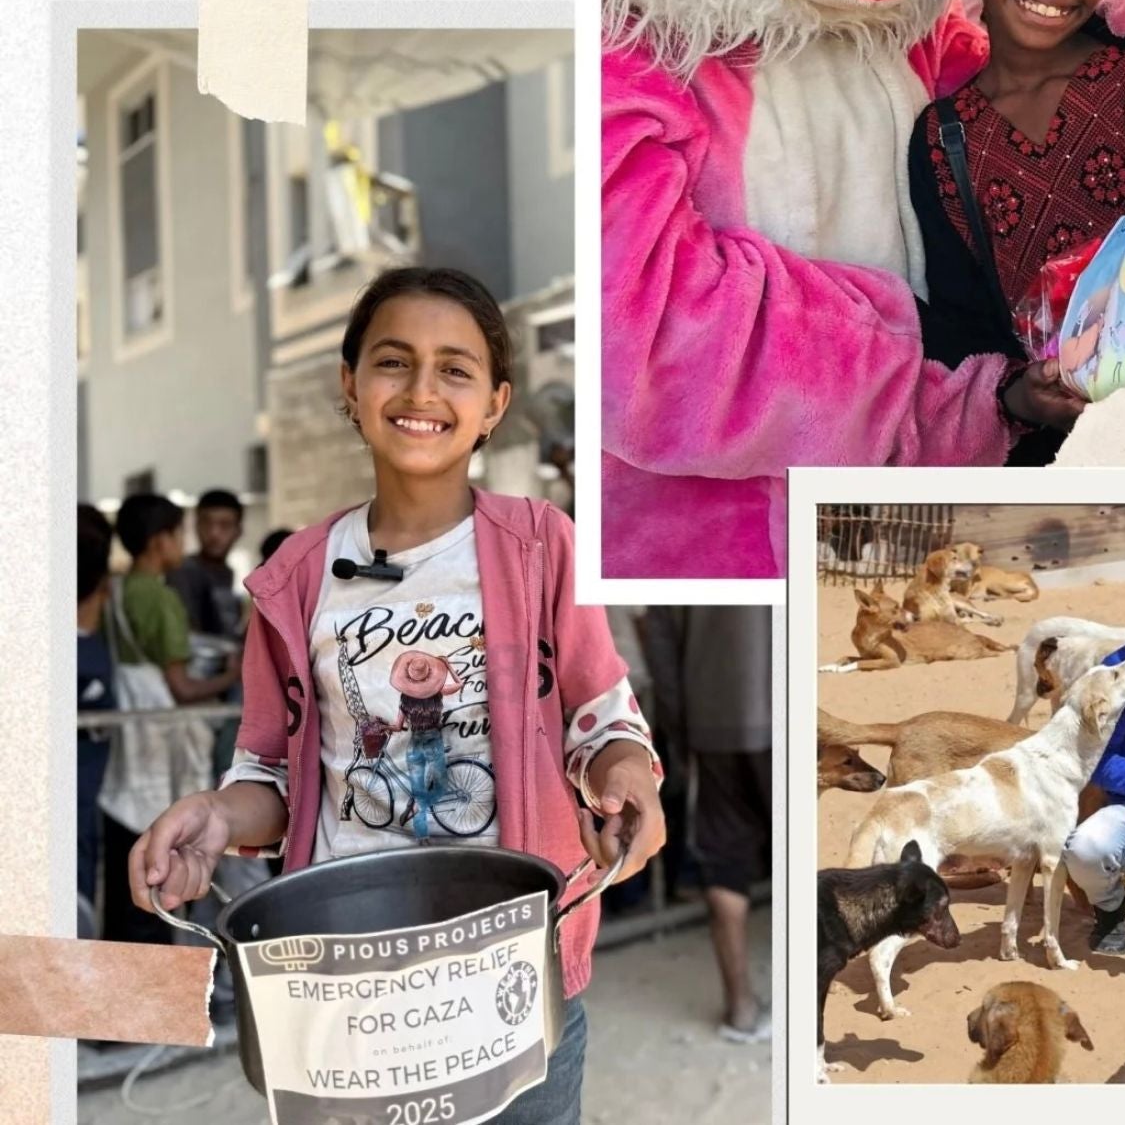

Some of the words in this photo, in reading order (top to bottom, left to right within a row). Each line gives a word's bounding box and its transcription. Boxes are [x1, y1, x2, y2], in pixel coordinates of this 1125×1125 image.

[333, 938, 409, 960] PIOUS
[418, 903, 533, 952] PROJECTS
[287, 967, 440, 1002] EMERGENCY
[447, 943, 519, 979] RELIEF
[347, 1013, 397, 1036] FOR
[403, 996, 474, 1029] GAZA
[306, 1069, 381, 1090] WEAR
[387, 1059, 438, 1086] THE
[444, 1032, 517, 1075] PEACE
[386, 1093, 456, 1125] 2025
